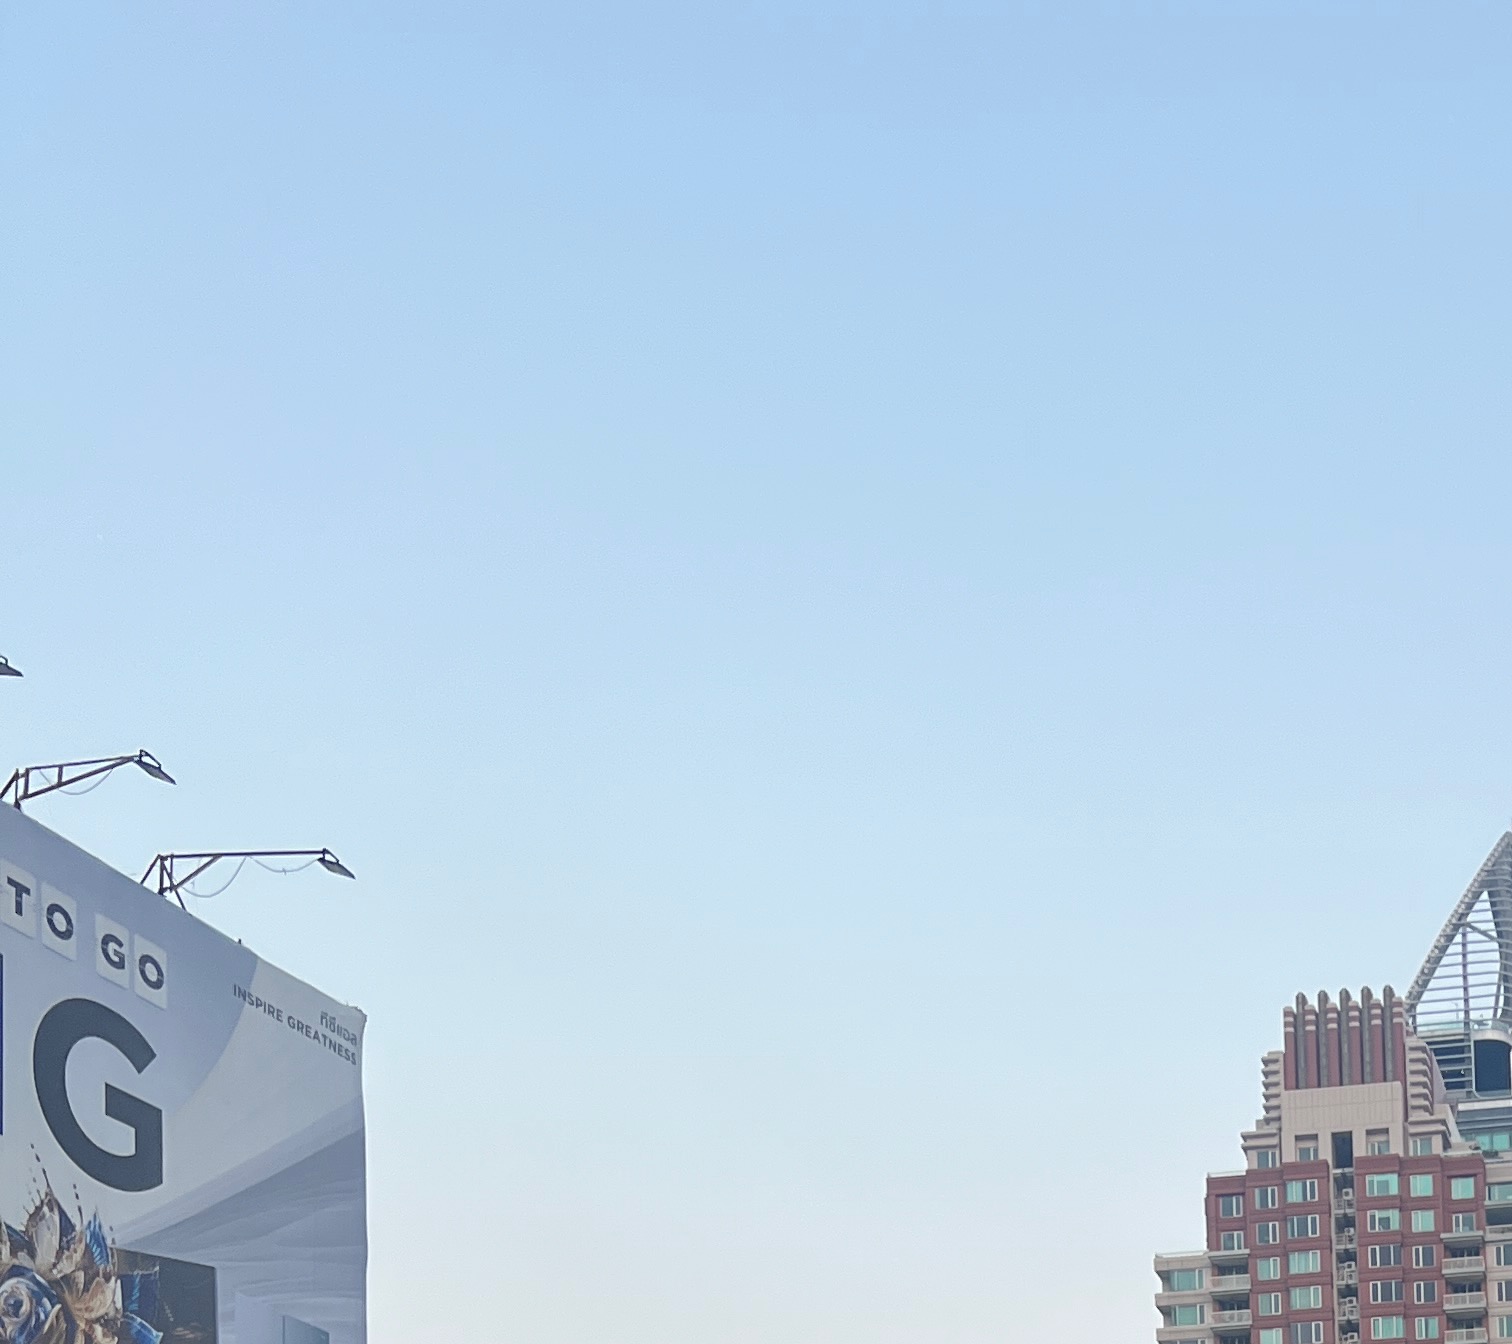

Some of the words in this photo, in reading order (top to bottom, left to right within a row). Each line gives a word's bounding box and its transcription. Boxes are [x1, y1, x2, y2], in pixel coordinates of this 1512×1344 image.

[7, 876, 74, 941] TO
[101, 933, 164, 990] GO
[233, 984, 283, 1023] INSPIRE
[287, 1015, 357, 1066] GREATNESS
